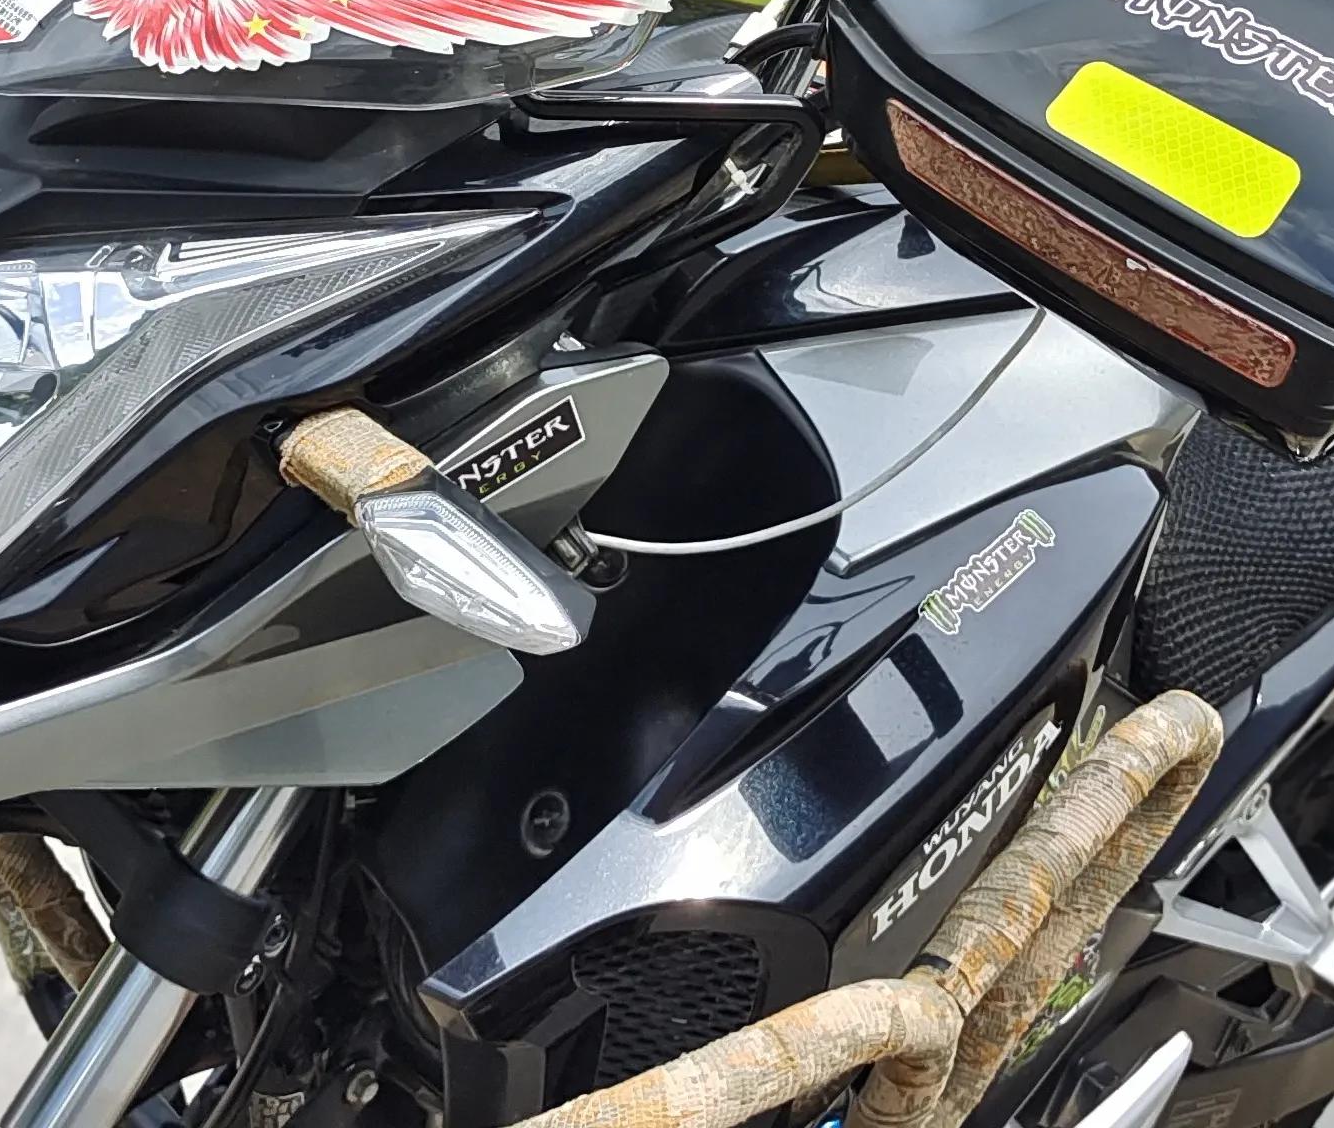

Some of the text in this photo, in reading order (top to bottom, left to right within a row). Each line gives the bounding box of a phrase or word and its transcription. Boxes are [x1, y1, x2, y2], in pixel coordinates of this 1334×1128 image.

[457, 415, 571, 490] NSTER
[945, 529, 1033, 611] MONSTER
[871, 718, 1064, 942] HONDA
[922, 736, 1024, 855] WUYANG
